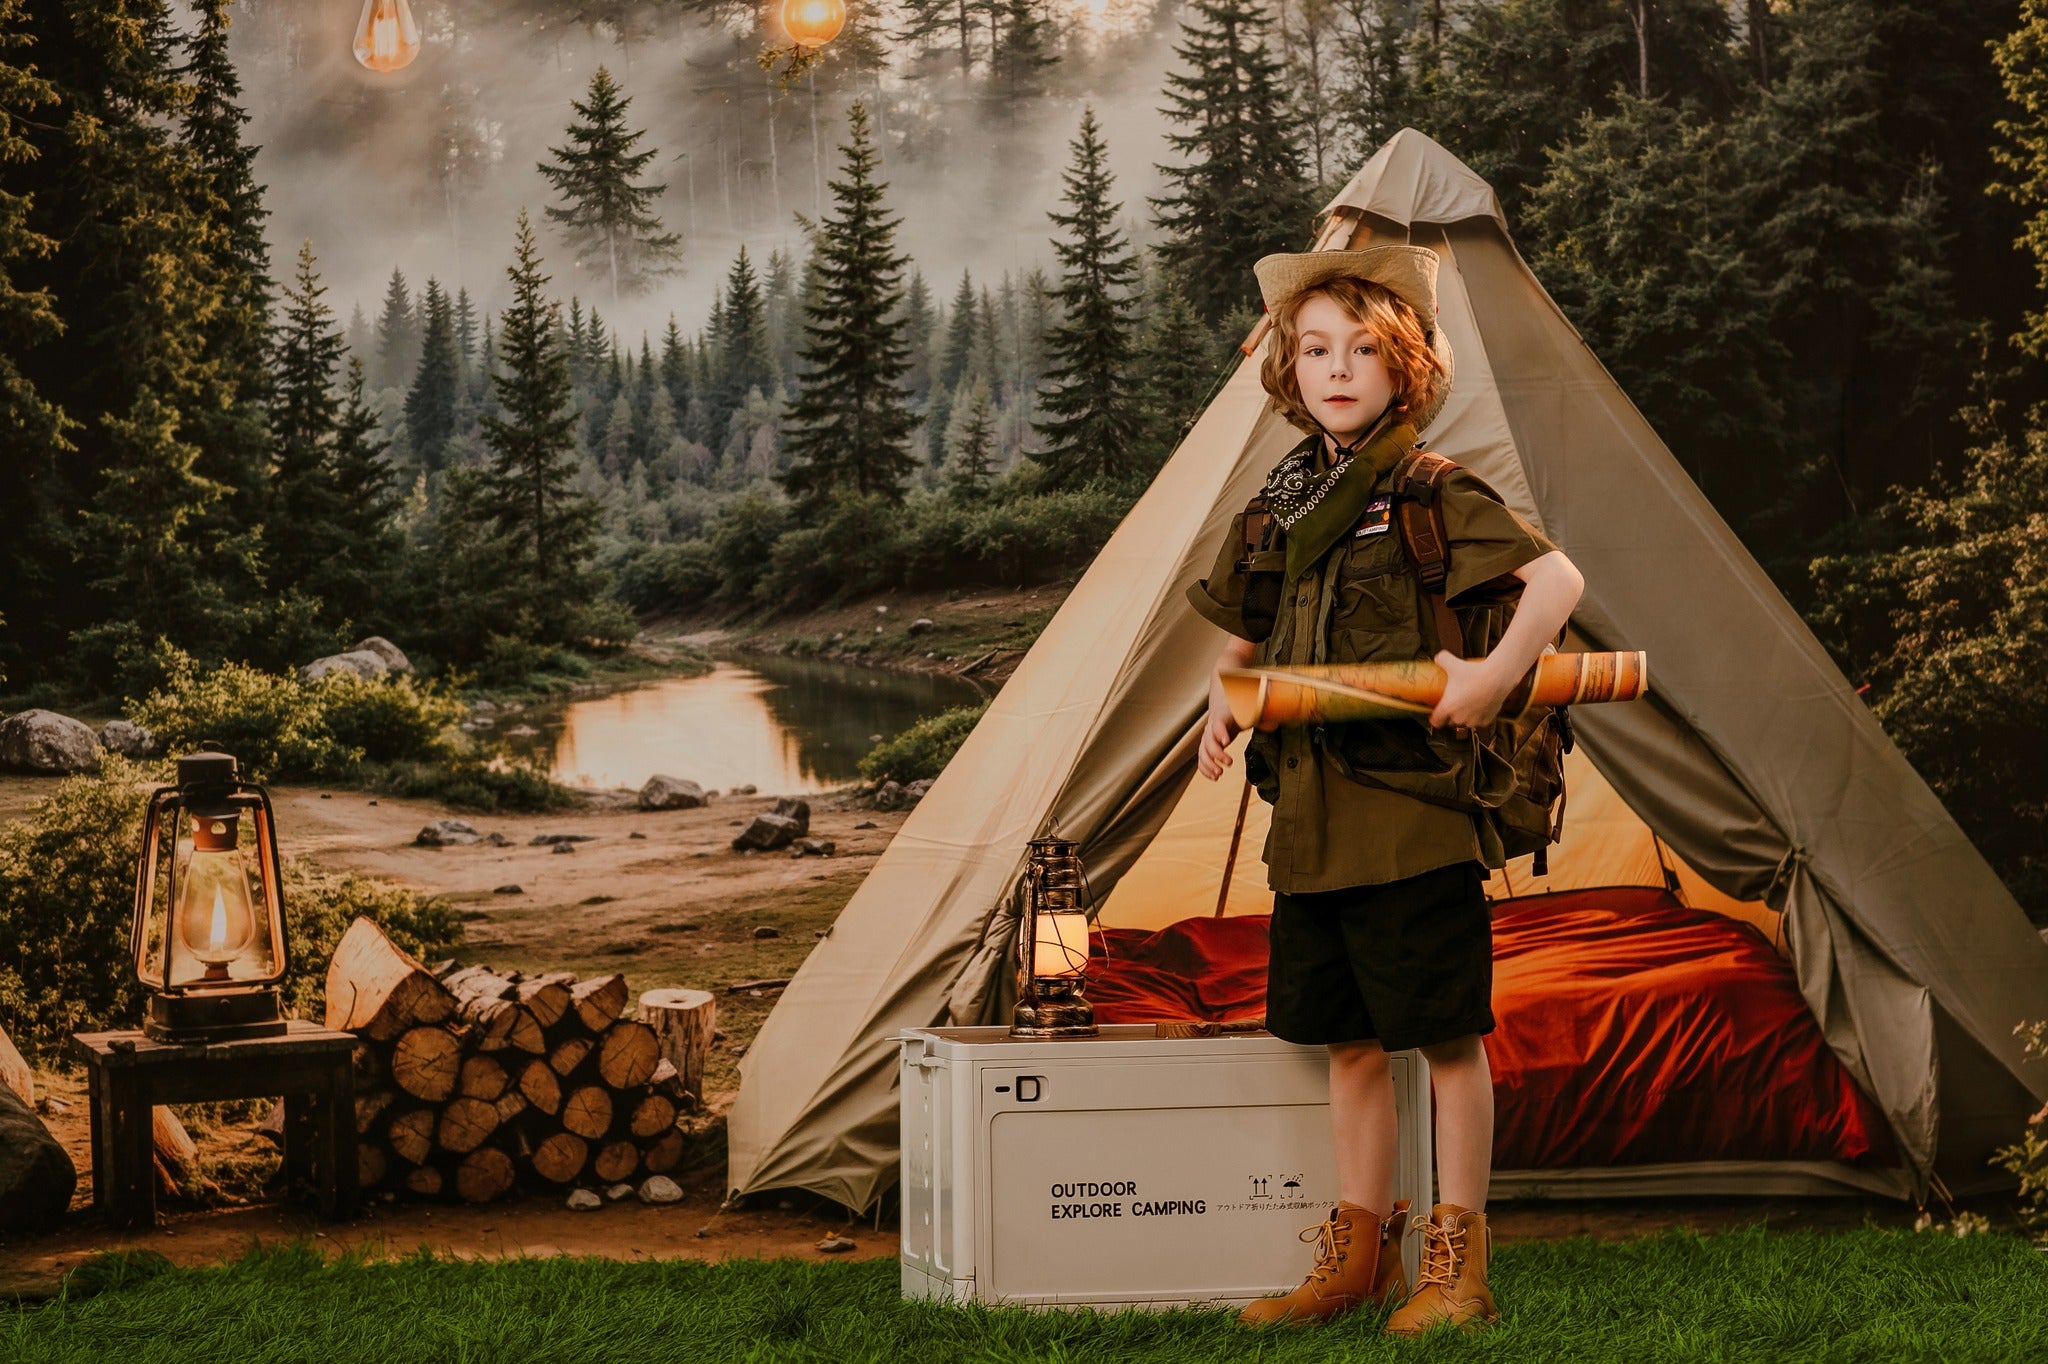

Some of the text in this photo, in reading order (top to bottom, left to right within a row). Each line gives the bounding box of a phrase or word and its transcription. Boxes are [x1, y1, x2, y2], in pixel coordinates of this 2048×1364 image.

[1051, 1181, 1137, 1198] OUTDOOR
[1051, 1200, 1206, 1219] EXPLORE CAMPING
